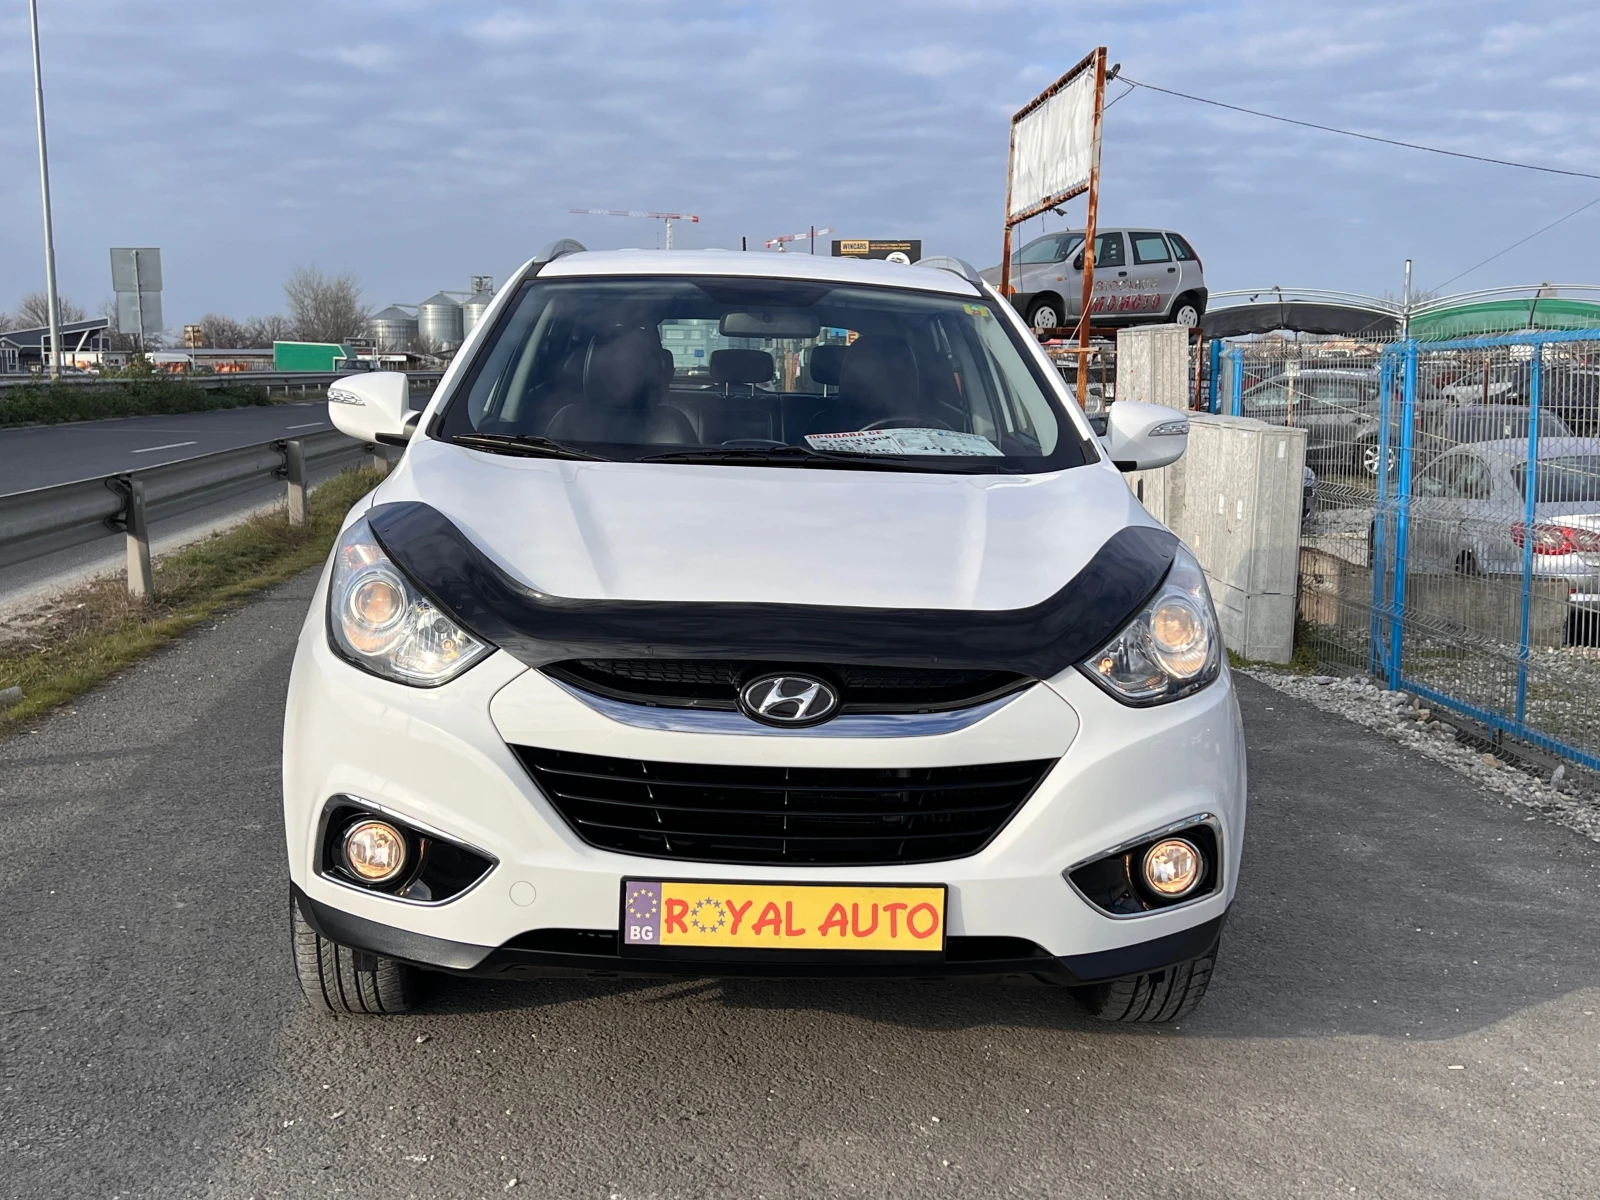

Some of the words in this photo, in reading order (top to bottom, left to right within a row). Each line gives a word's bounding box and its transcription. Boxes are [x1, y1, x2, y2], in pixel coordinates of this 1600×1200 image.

[808, 431, 865, 440] ПРОДАВА
[664, 896, 806, 937] ROYAL
[817, 902, 939, 939] AUTO
[630, 925, 653, 941] BG
